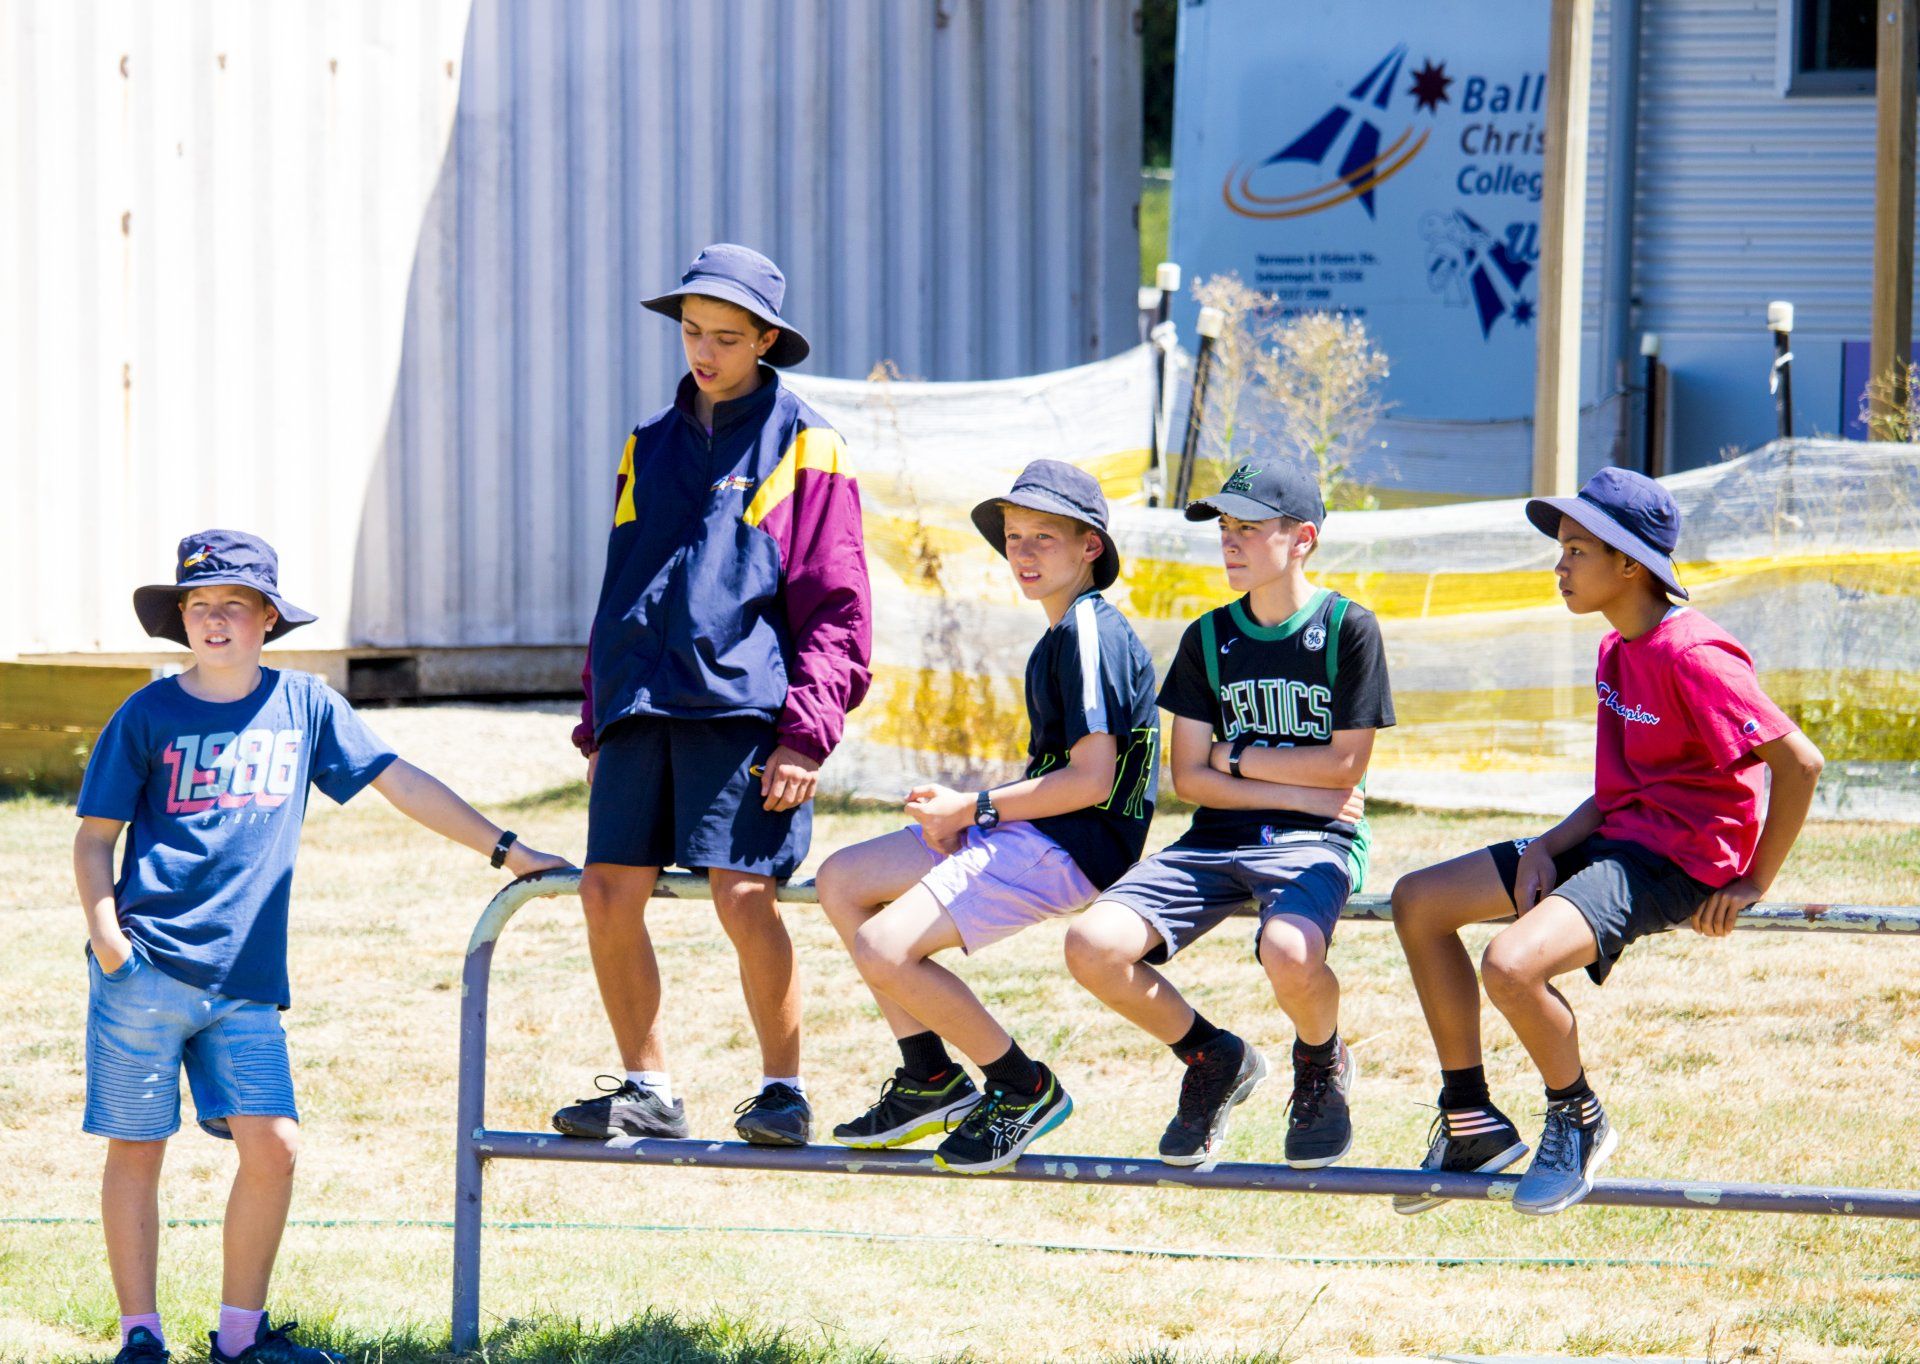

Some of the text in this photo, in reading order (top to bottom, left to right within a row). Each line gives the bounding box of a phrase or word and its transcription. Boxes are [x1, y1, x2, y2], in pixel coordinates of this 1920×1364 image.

[1462, 74, 1546, 113] Ball
[1220, 678, 1332, 742] CELTICS
[171, 729, 303, 801] 1986
